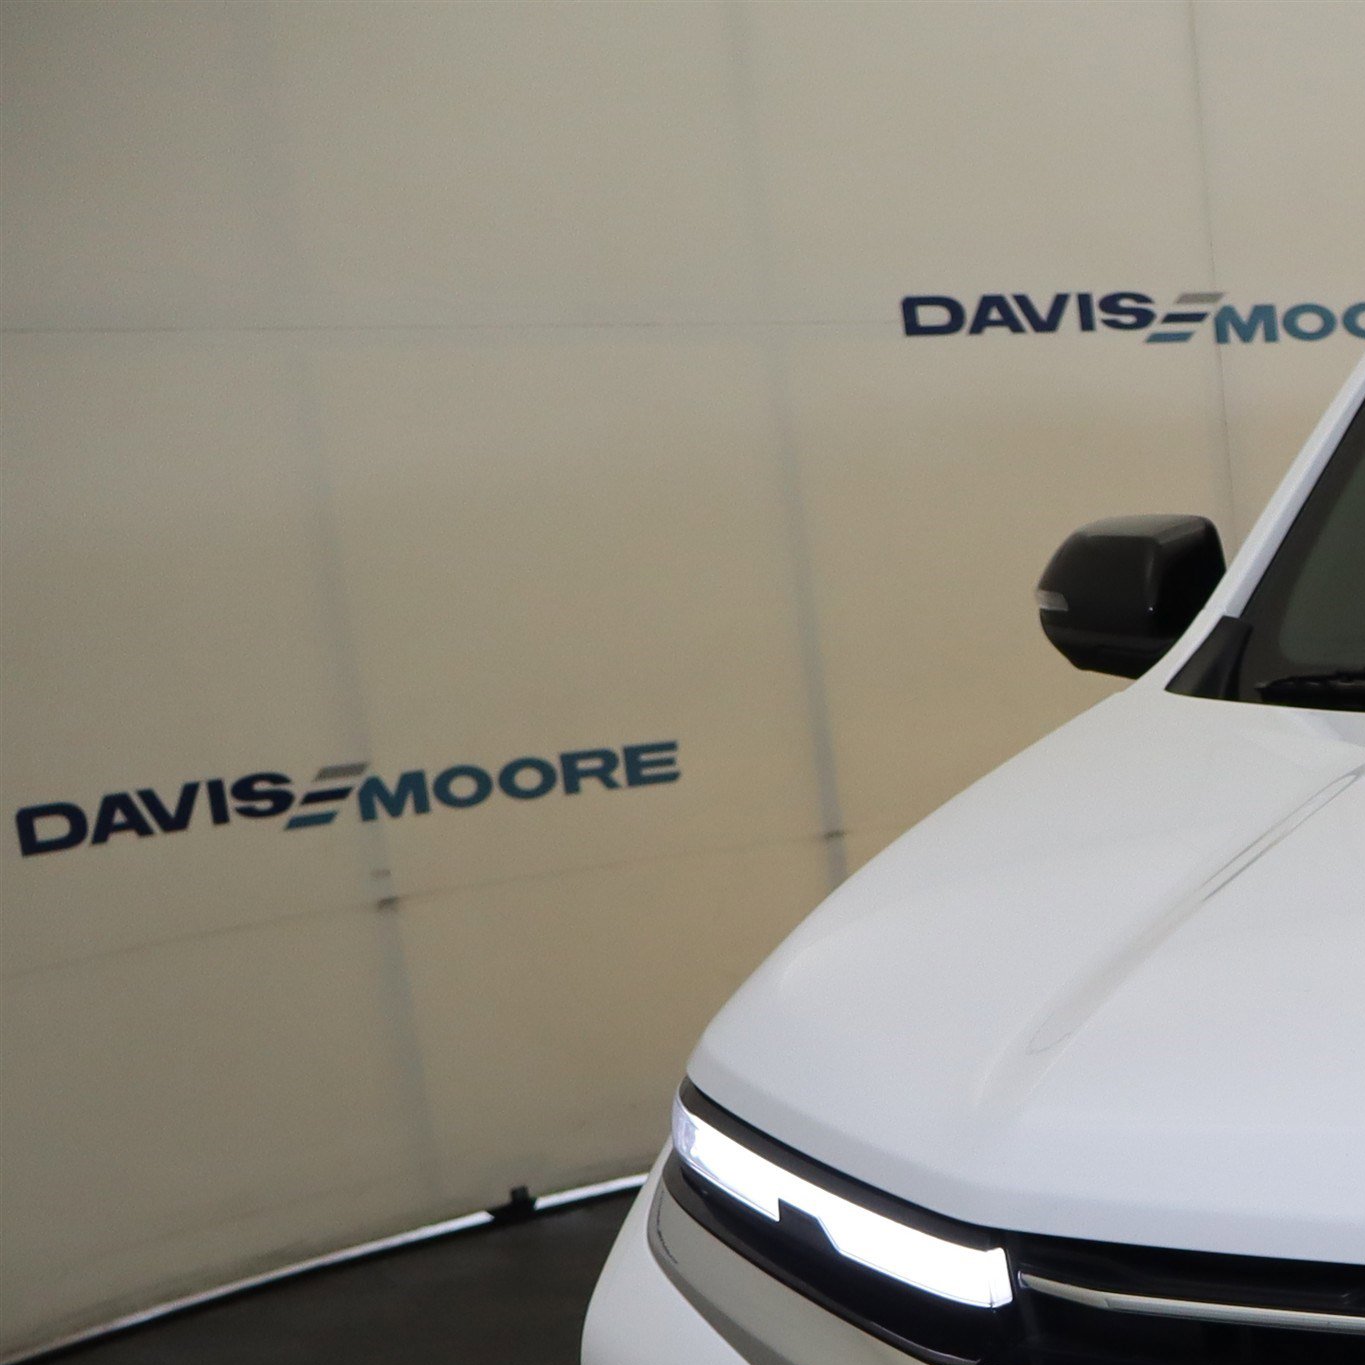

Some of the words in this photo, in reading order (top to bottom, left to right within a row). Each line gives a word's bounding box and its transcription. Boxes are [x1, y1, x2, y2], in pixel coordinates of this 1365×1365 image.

[902, 291, 1157, 338] DAVIS
[15, 772, 296, 857] DAVIS
[357, 740, 682, 822] MOORE
